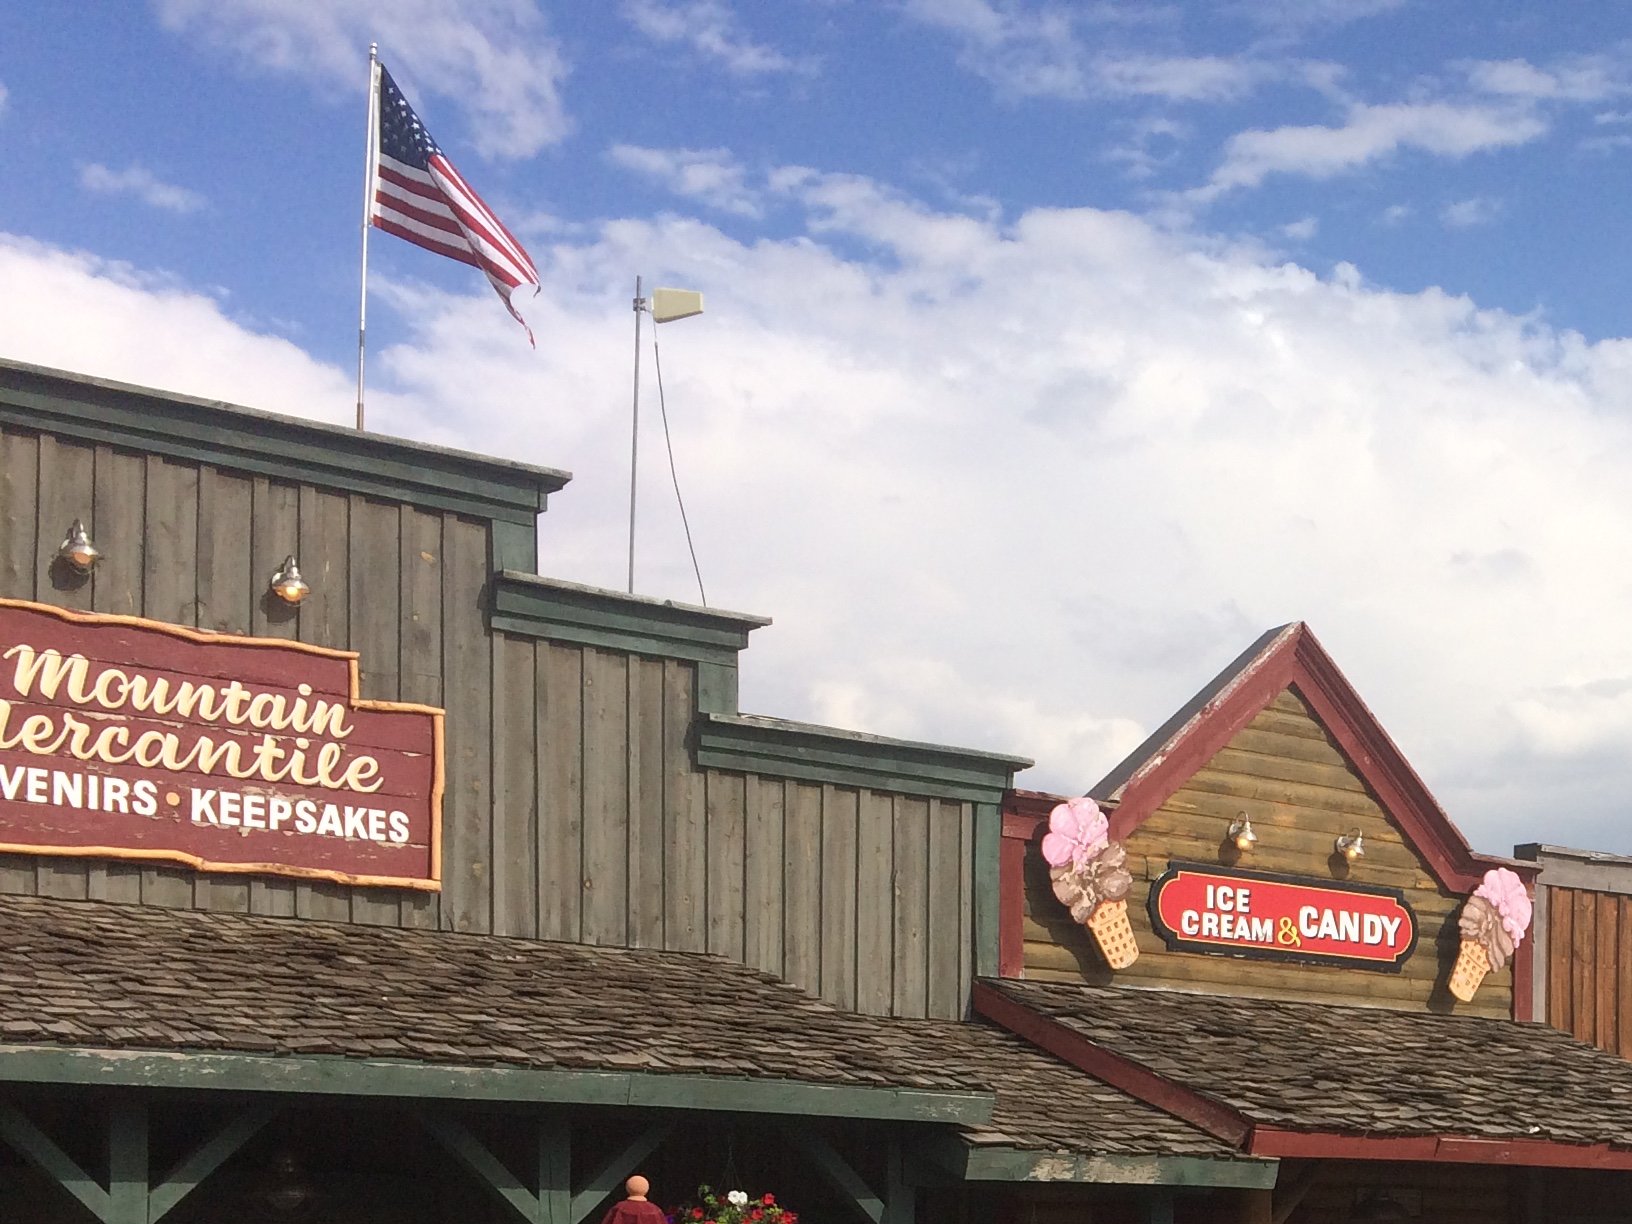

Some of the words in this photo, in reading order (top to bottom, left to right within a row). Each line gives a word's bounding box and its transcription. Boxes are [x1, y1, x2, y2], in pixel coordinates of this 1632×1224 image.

[3, 643, 354, 740] Mountain
[0, 700, 385, 794] ercantile
[191, 787, 410, 844] KEEPSAKES
[1181, 910, 1274, 943] CREAM
[1277, 916, 1301, 948] &
[1299, 905, 1402, 947] CANDY
[1206, 885, 1250, 913] ICE
